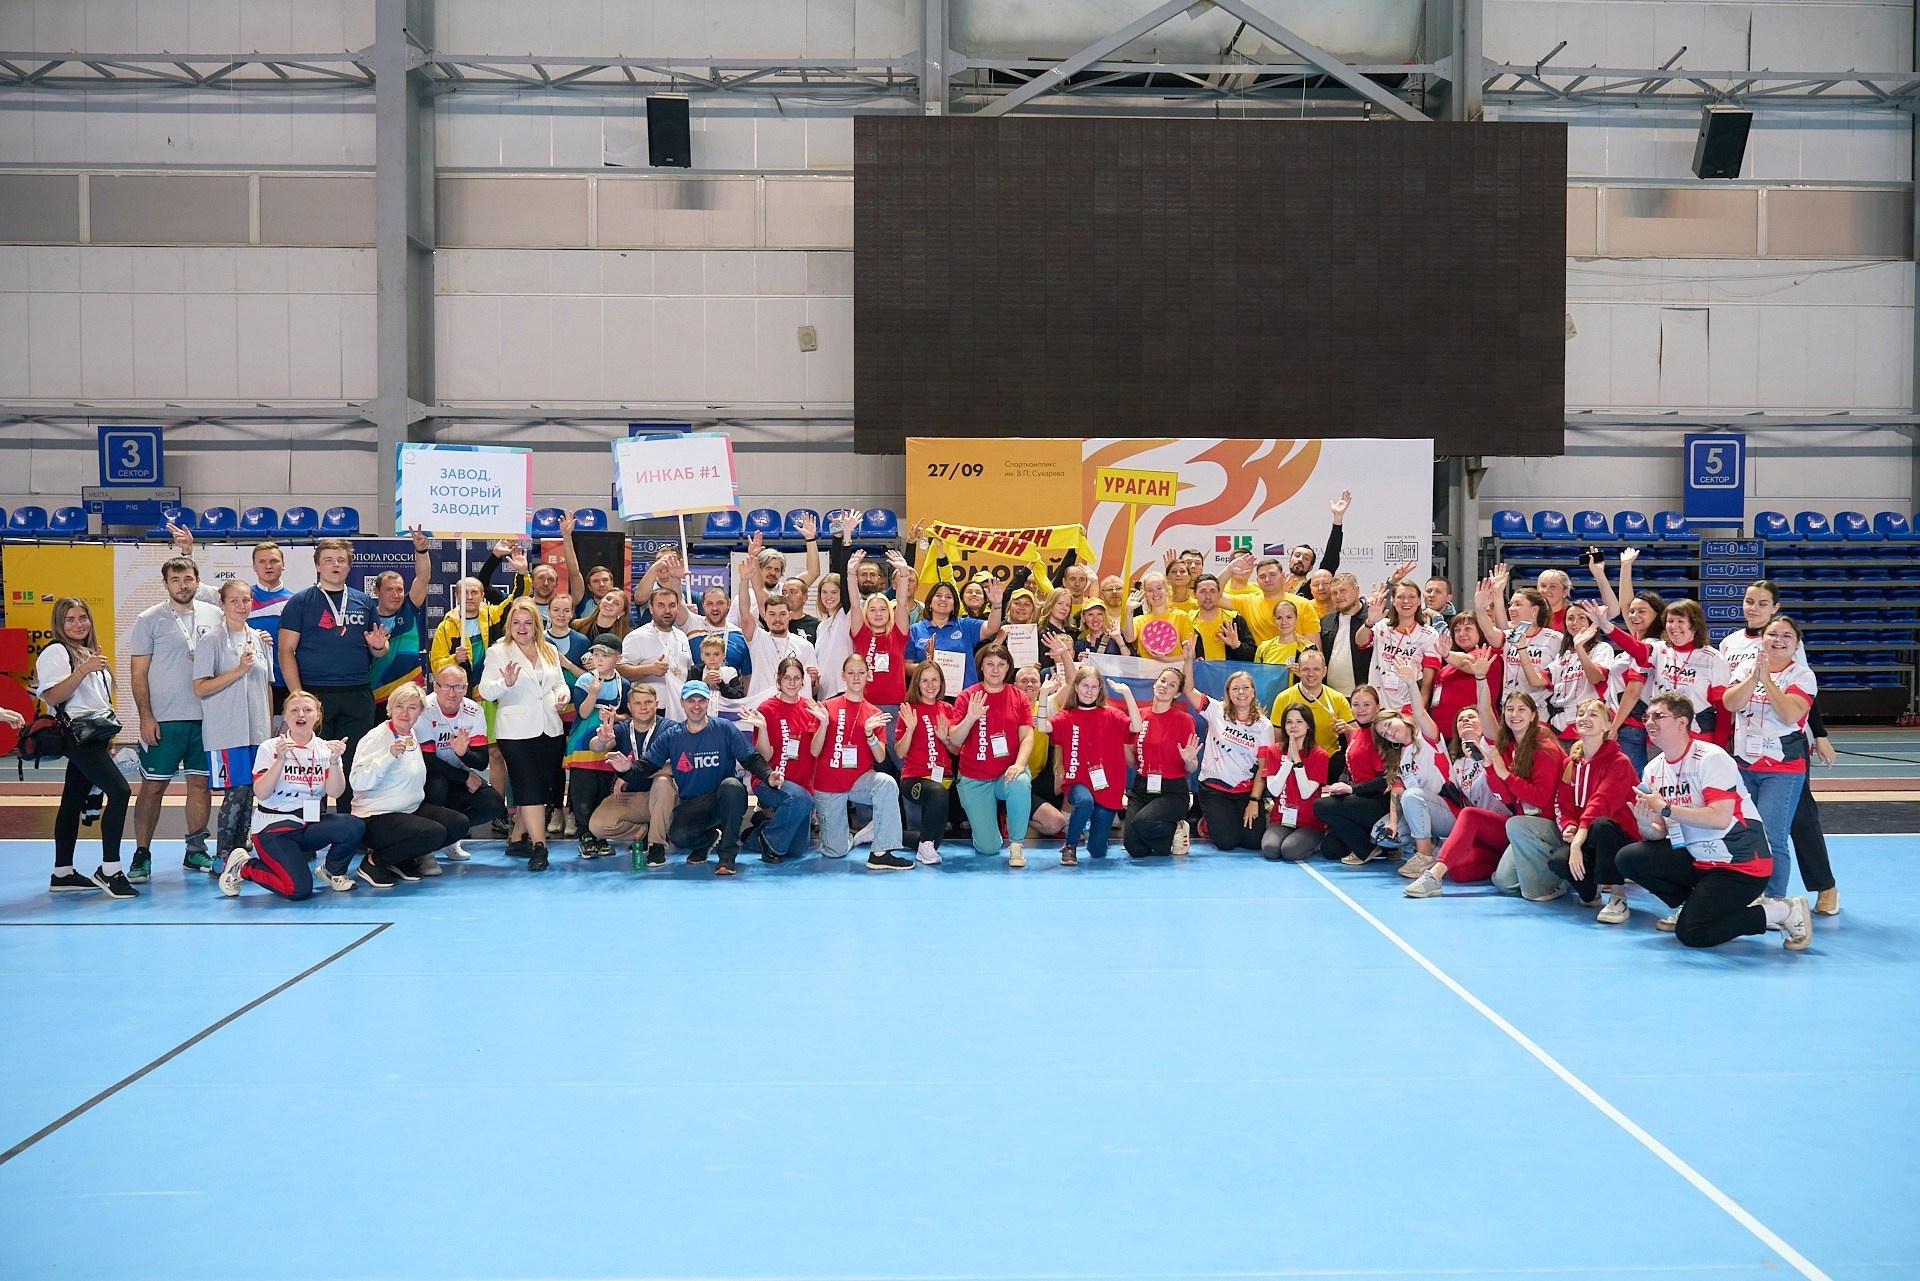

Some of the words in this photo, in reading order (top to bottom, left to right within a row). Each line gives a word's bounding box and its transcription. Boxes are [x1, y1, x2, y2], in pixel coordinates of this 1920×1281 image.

[121, 439, 141, 468] 3
[1004, 460, 1057, 469] Спорткомплекс
[1705, 447, 1723, 475] 5
[118, 469, 150, 477] СЕКТОР
[440, 468, 491, 482] ЗАВОД,
[636, 467, 695, 485] ИНКАБ
[699, 465, 721, 479] #1
[927, 462, 984, 481] 27/09
[1031, 470, 1065, 478] Сухарева
[430, 485, 502, 498] КОТОРЫЙ
[1103, 476, 1170, 497] УРАГАН
[431, 503, 500, 517] ЗАВОДИТ
[648, 542, 654, 551] 8
[1729, 544, 1735, 553] 8
[352, 553, 381, 561] ОПОРА
[220, 571, 236, 579] РБК
[1729, 565, 1735, 574] 7
[1728, 586, 1734, 595] 6
[1730, 608, 1736, 617] 5
[1727, 653, 1756, 662] ИГРА
[829, 708, 846, 769] Берегиня
[922, 714, 939, 769] Берегиня
[976, 714, 989, 761] Береги
[1065, 725, 1080, 779] Берегиня
[693, 755, 720, 769] ПСС
[218, 764, 228, 781] 4
[284, 764, 323, 775] ИГРАЙ
[284, 774, 324, 783] ПОМОАЙ
[1664, 796, 1692, 806] ОМОГАЙ
